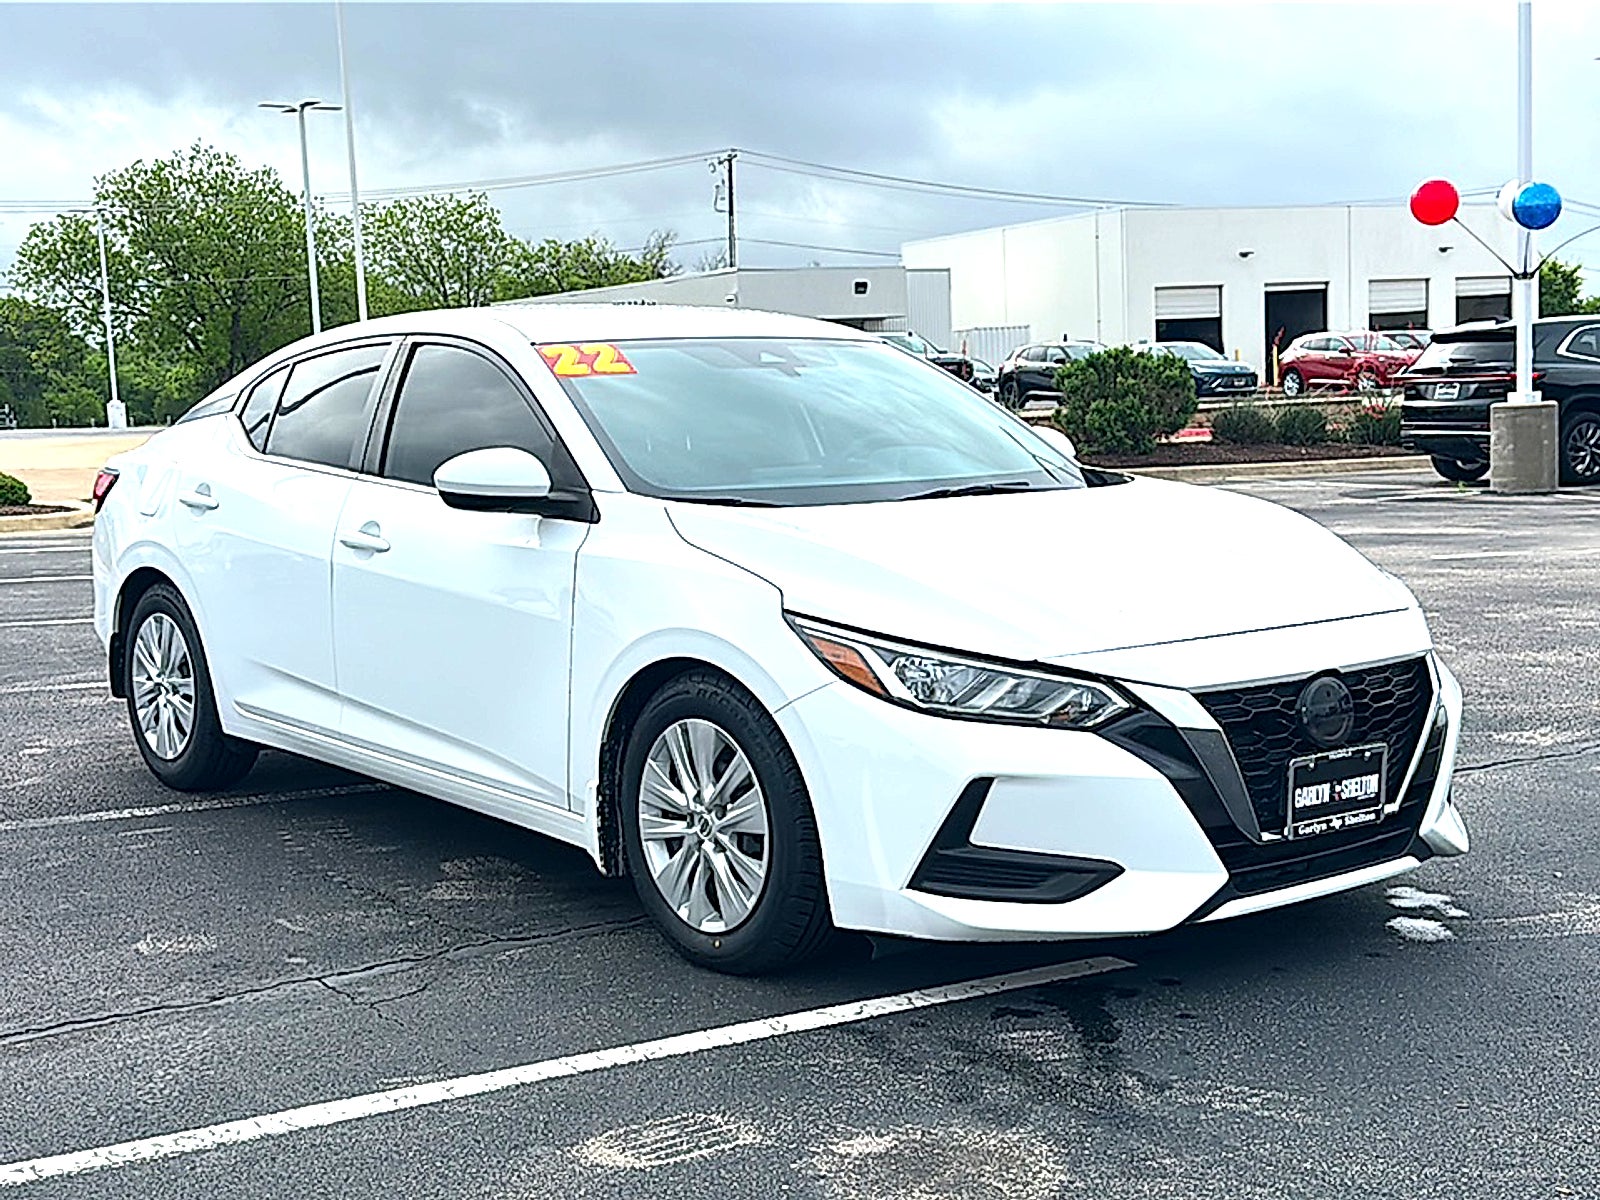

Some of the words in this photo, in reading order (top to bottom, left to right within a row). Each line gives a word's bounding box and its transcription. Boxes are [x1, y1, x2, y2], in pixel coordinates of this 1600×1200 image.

[541, 343, 631, 375] 22
[1341, 774, 1379, 799] SHELTON
[1344, 812, 1376, 826] Shelton
